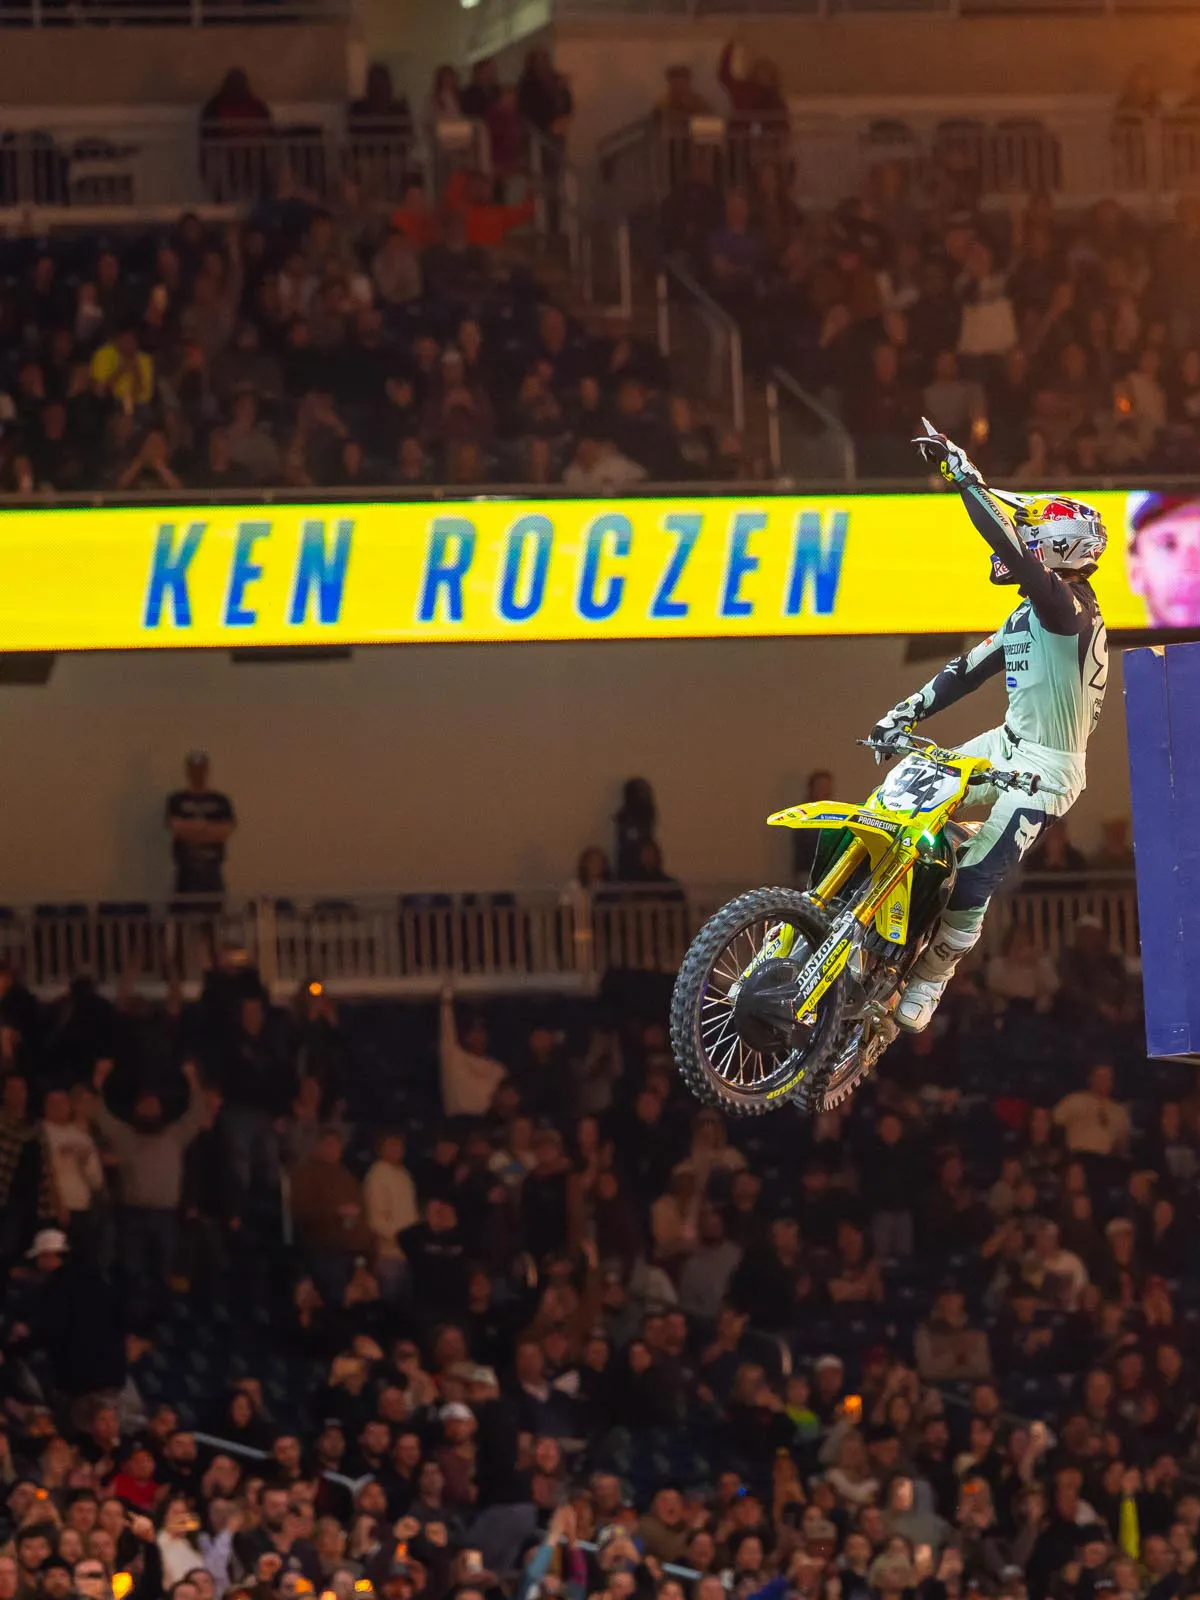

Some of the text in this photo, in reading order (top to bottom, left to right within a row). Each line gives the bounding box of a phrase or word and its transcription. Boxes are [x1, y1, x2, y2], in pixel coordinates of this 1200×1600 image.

[142, 511, 849, 628] KEN ROCZEN
[886, 766, 946, 806] 94
[857, 815, 898, 833] PROGRESSIVE
[797, 934, 835, 987] DUNLOP
